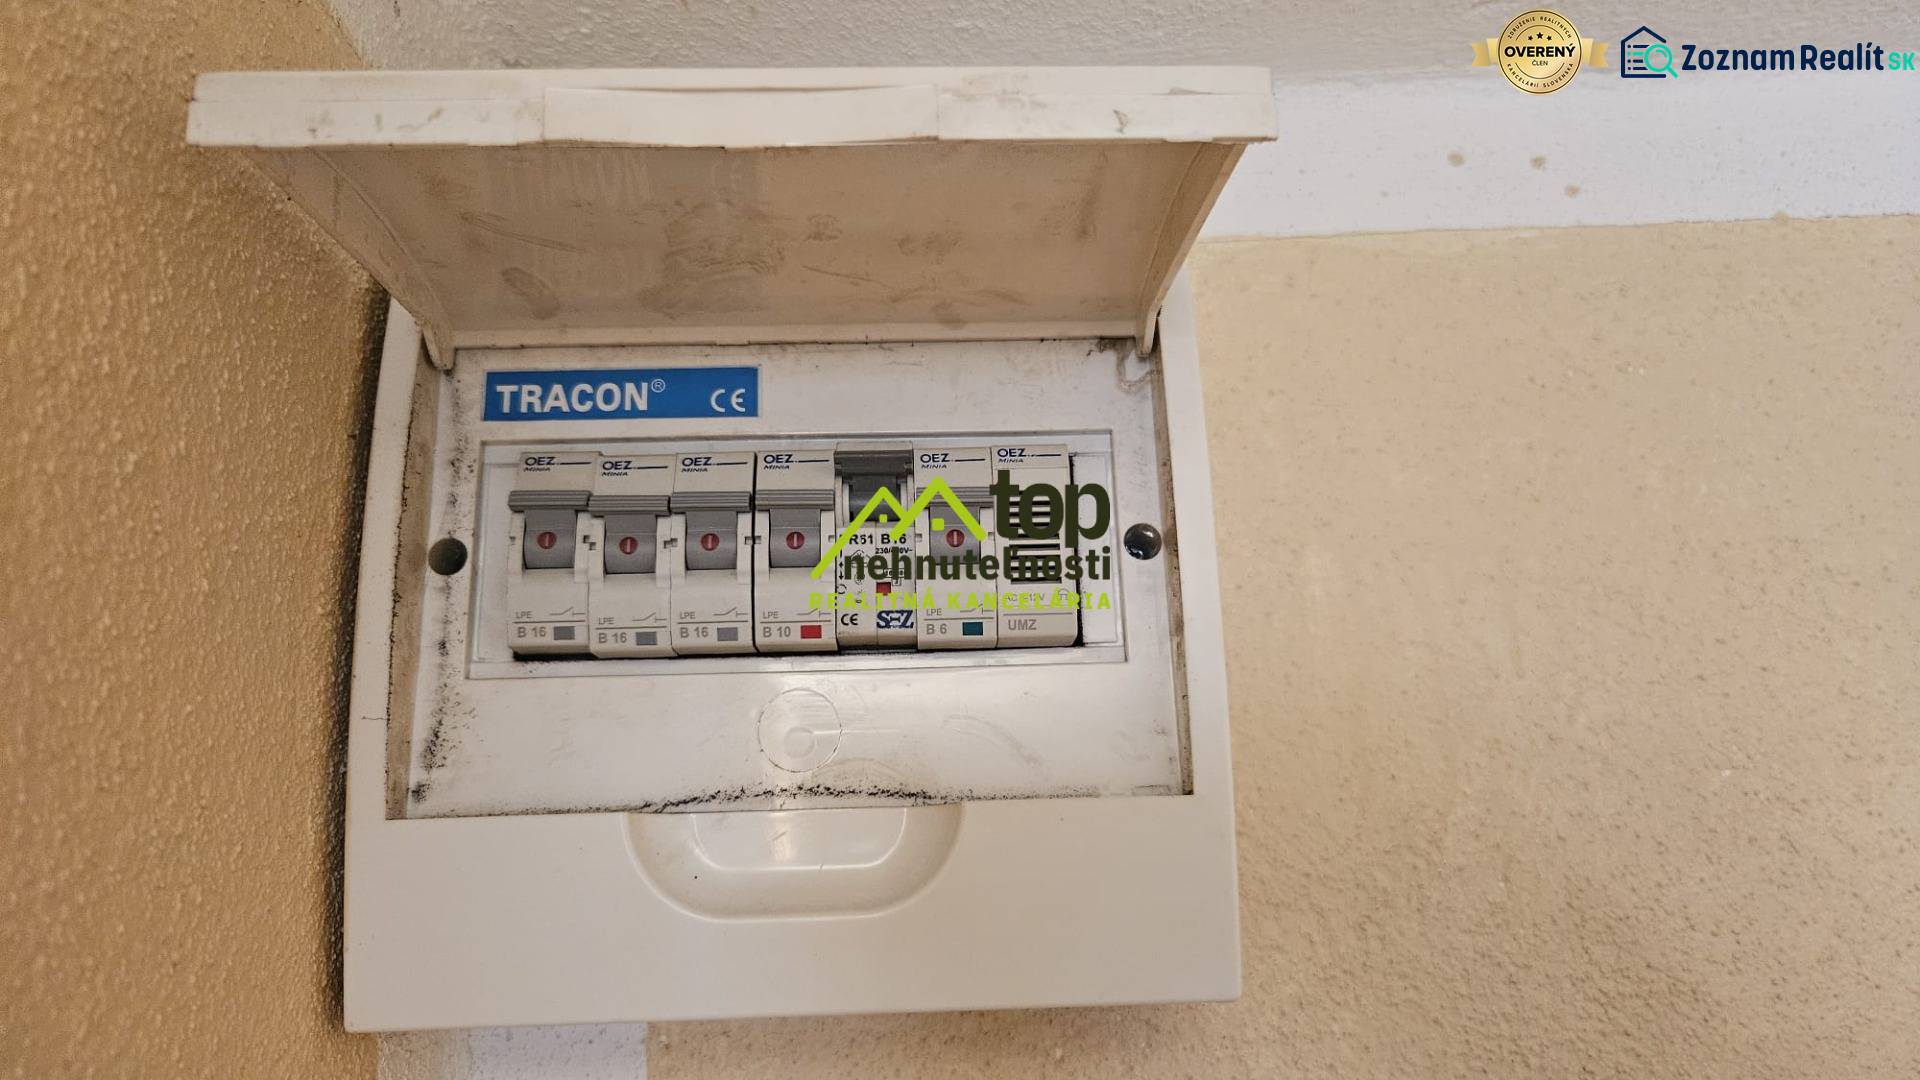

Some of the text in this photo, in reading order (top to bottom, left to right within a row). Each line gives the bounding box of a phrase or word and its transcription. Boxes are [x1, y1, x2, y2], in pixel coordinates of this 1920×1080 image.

[920, 453, 949, 463] OEZ
[997, 448, 1026, 458] OEZ
[524, 456, 556, 466] OEZ
[681, 456, 713, 467] OEZ
[763, 454, 794, 464] OEZ
[602, 460, 633, 471] OEZ
[516, 611, 532, 619] LPE
[679, 611, 696, 620] LPE
[762, 611, 779, 619] LPE
[926, 608, 942, 616] LPE
[598, 617, 614, 625] LPE
[1008, 619, 1037, 630] UMZ
[517, 626, 547, 638] B 16
[680, 626, 709, 638] B 16
[763, 626, 791, 638] B 10
[926, 624, 947, 635] B 6
[598, 632, 627, 643] B 16
